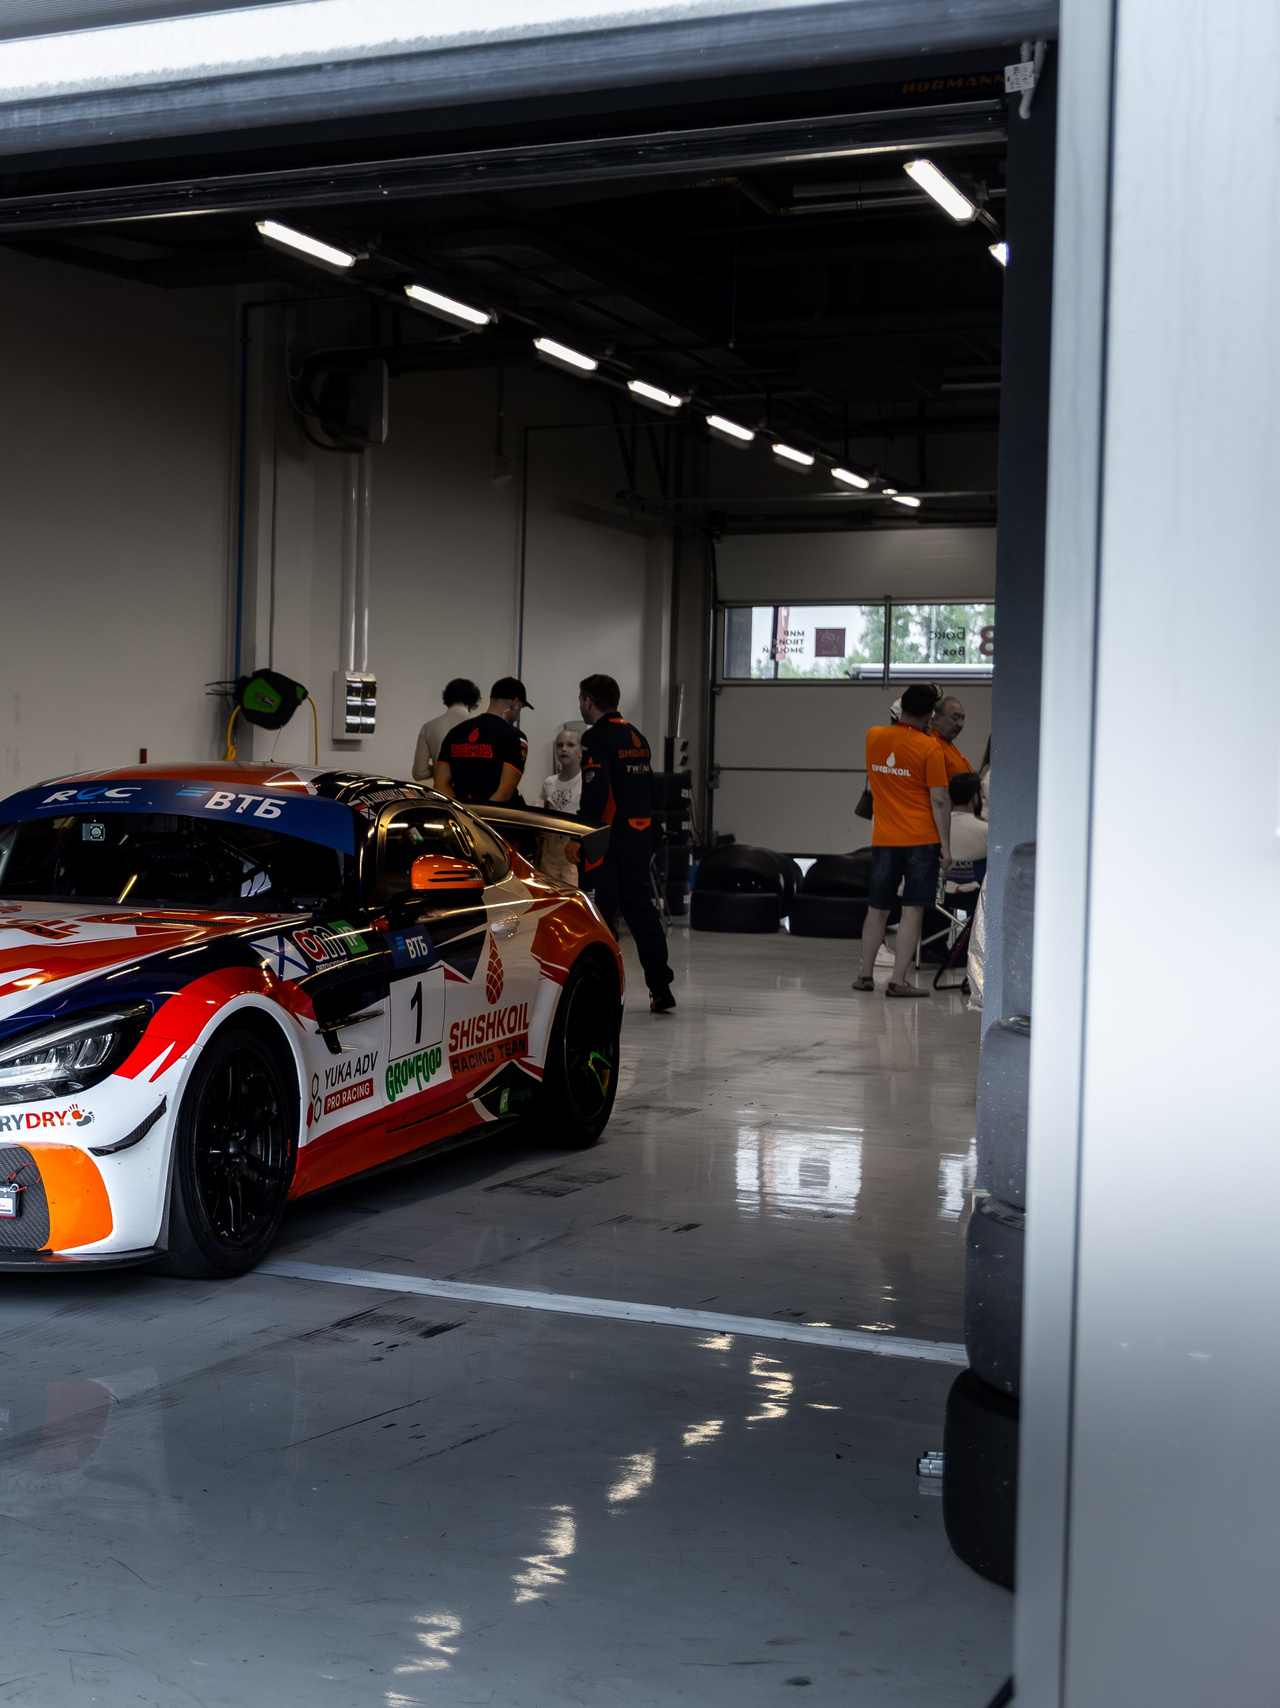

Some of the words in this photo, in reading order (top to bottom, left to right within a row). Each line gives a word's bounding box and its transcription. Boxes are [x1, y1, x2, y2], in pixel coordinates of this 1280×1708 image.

[204, 791, 287, 819] ВТБ
[405, 935, 429, 959] ВТБ
[411, 981, 423, 1045] 1
[448, 1002, 529, 1053] SHISHKOIL
[324, 1062, 352, 1090] YUKA
[353, 1050, 379, 1078] ADV
[451, 1048, 495, 1075] RACING
[497, 1036, 526, 1059] TEAM
[326, 1093, 344, 1112] PRO
[341, 1082, 371, 1106] RACING
